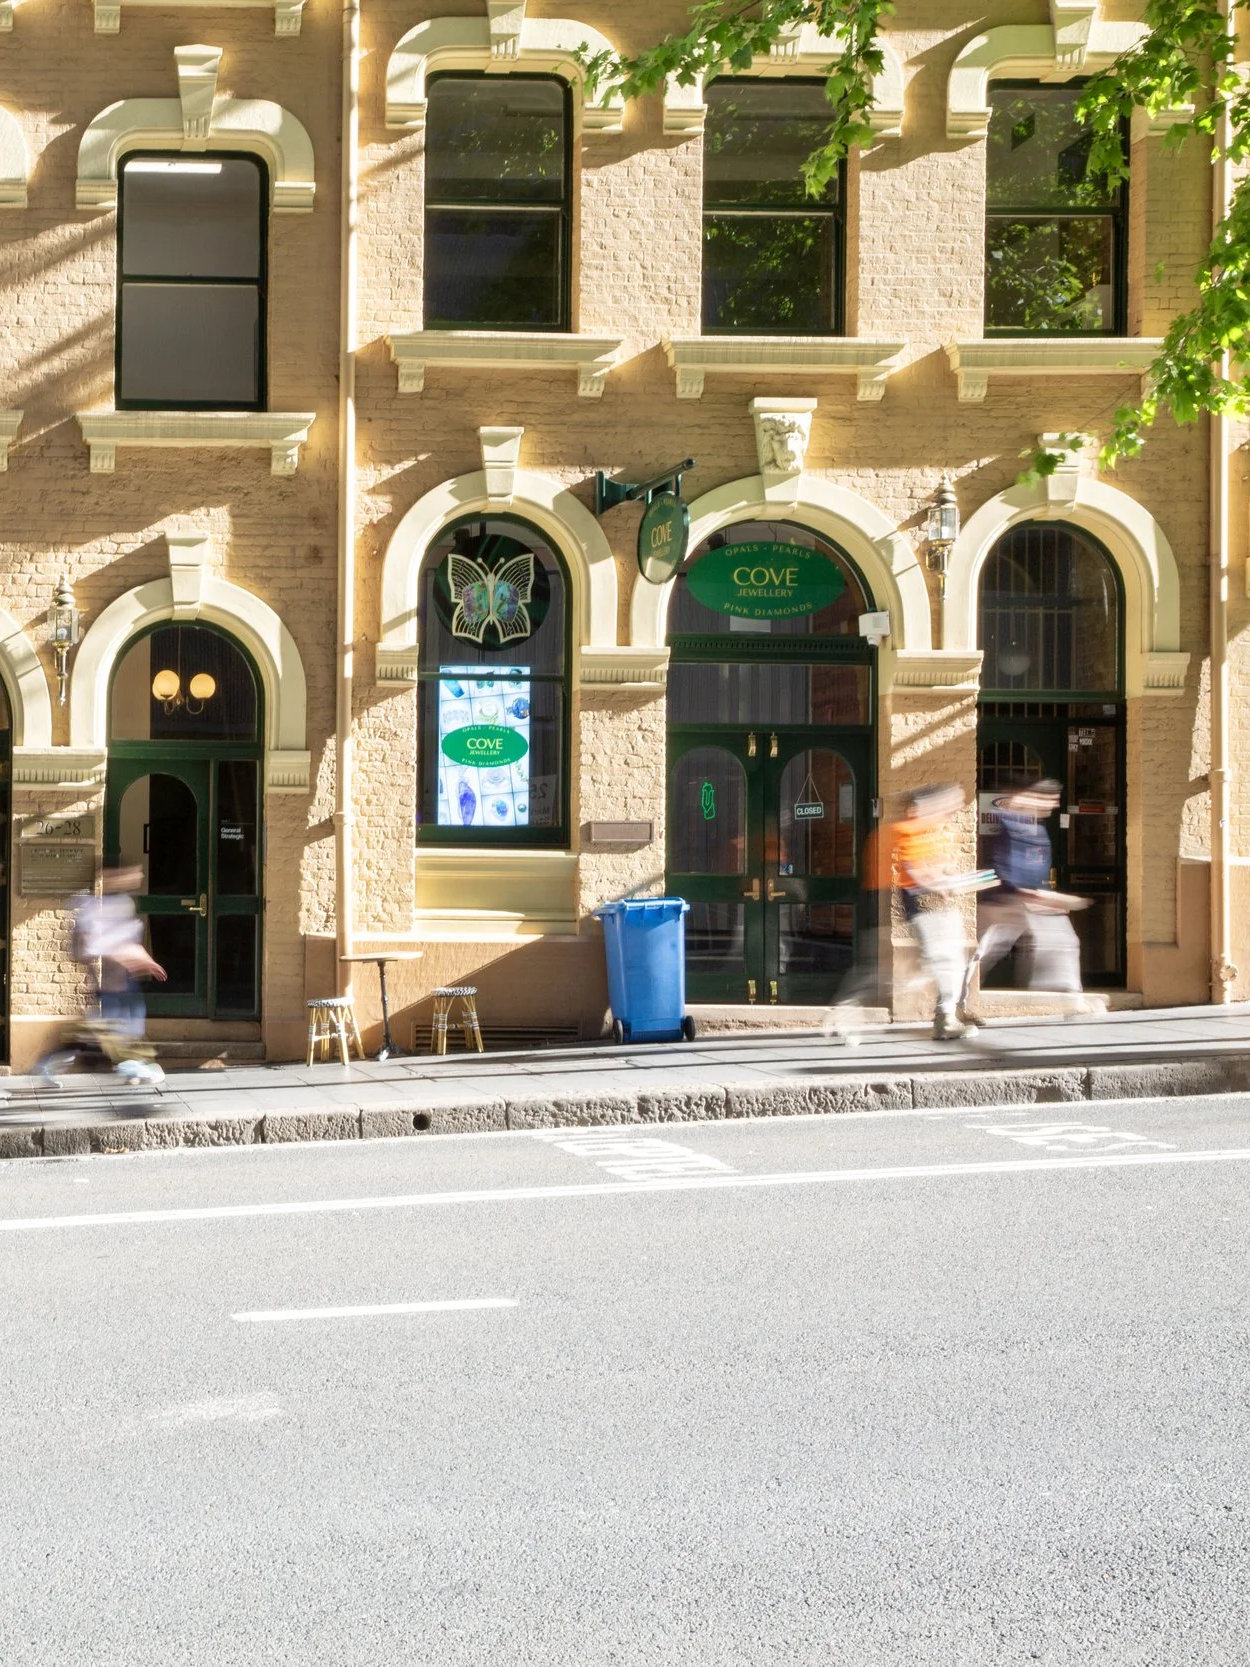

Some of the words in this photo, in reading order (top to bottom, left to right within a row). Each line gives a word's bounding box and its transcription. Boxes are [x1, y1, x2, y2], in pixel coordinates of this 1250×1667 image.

[651, 521, 673, 548] COVE
[725, 544, 759, 557] OPALS
[772, 545, 811, 560] PEARLS
[733, 566, 799, 587] COVE
[737, 588, 794, 598] JEWELLERY
[723, 602, 750, 615] PINK
[754, 601, 813, 617] DIAMONDS
[467, 738, 503, 749] COVE
[796, 807, 822, 816] CLOSED
[36, 820, 82, 836] 26-28
